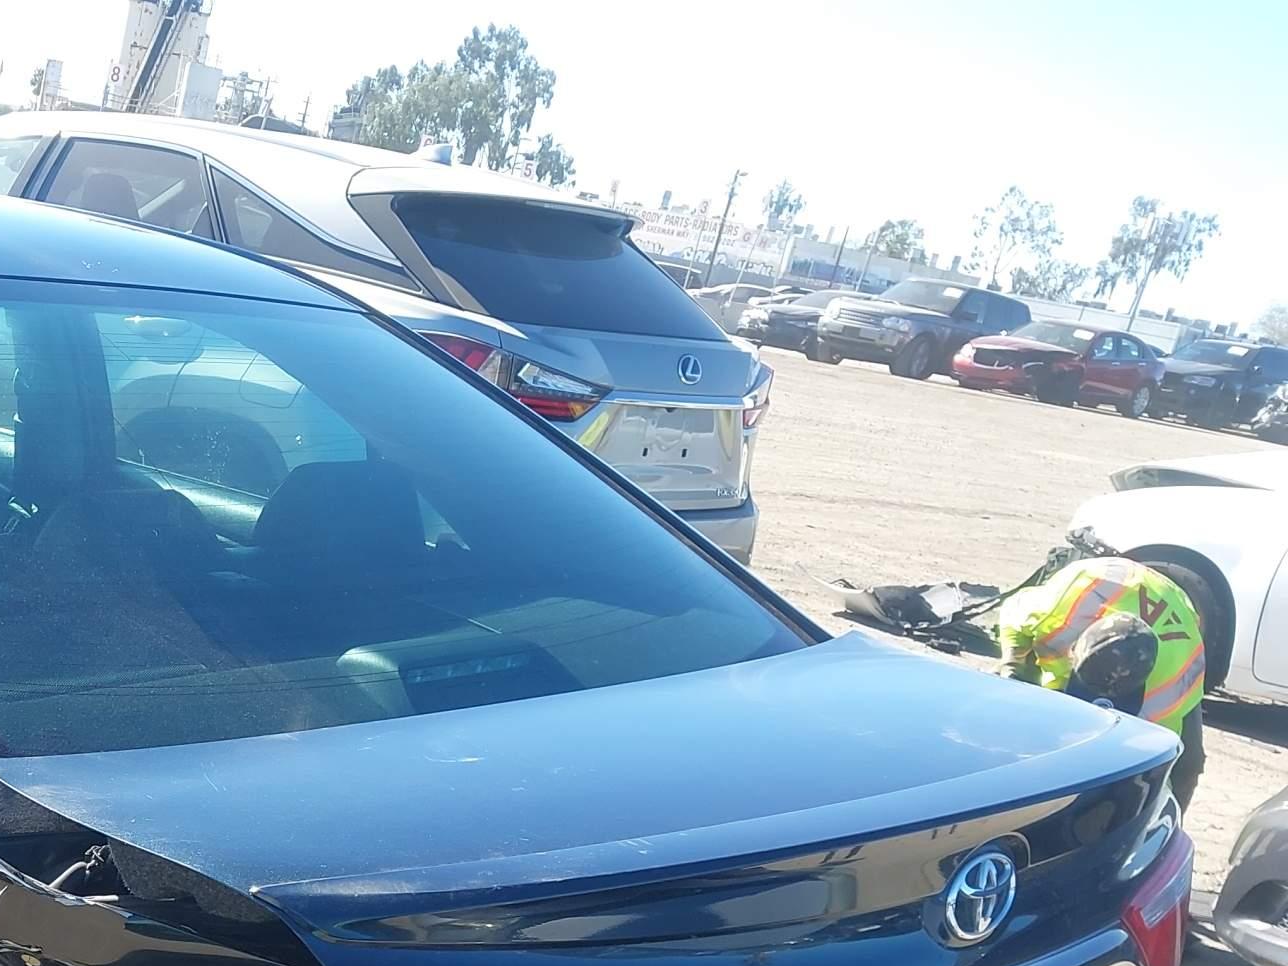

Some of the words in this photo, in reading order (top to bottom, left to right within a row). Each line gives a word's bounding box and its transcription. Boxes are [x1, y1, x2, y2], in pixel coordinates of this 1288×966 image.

[111, 66, 121, 82] 8
[524, 163, 533, 178] 5
[700, 201, 709, 214] 3
[743, 232, 752, 243] G
[1139, 584, 1192, 641] IAA
